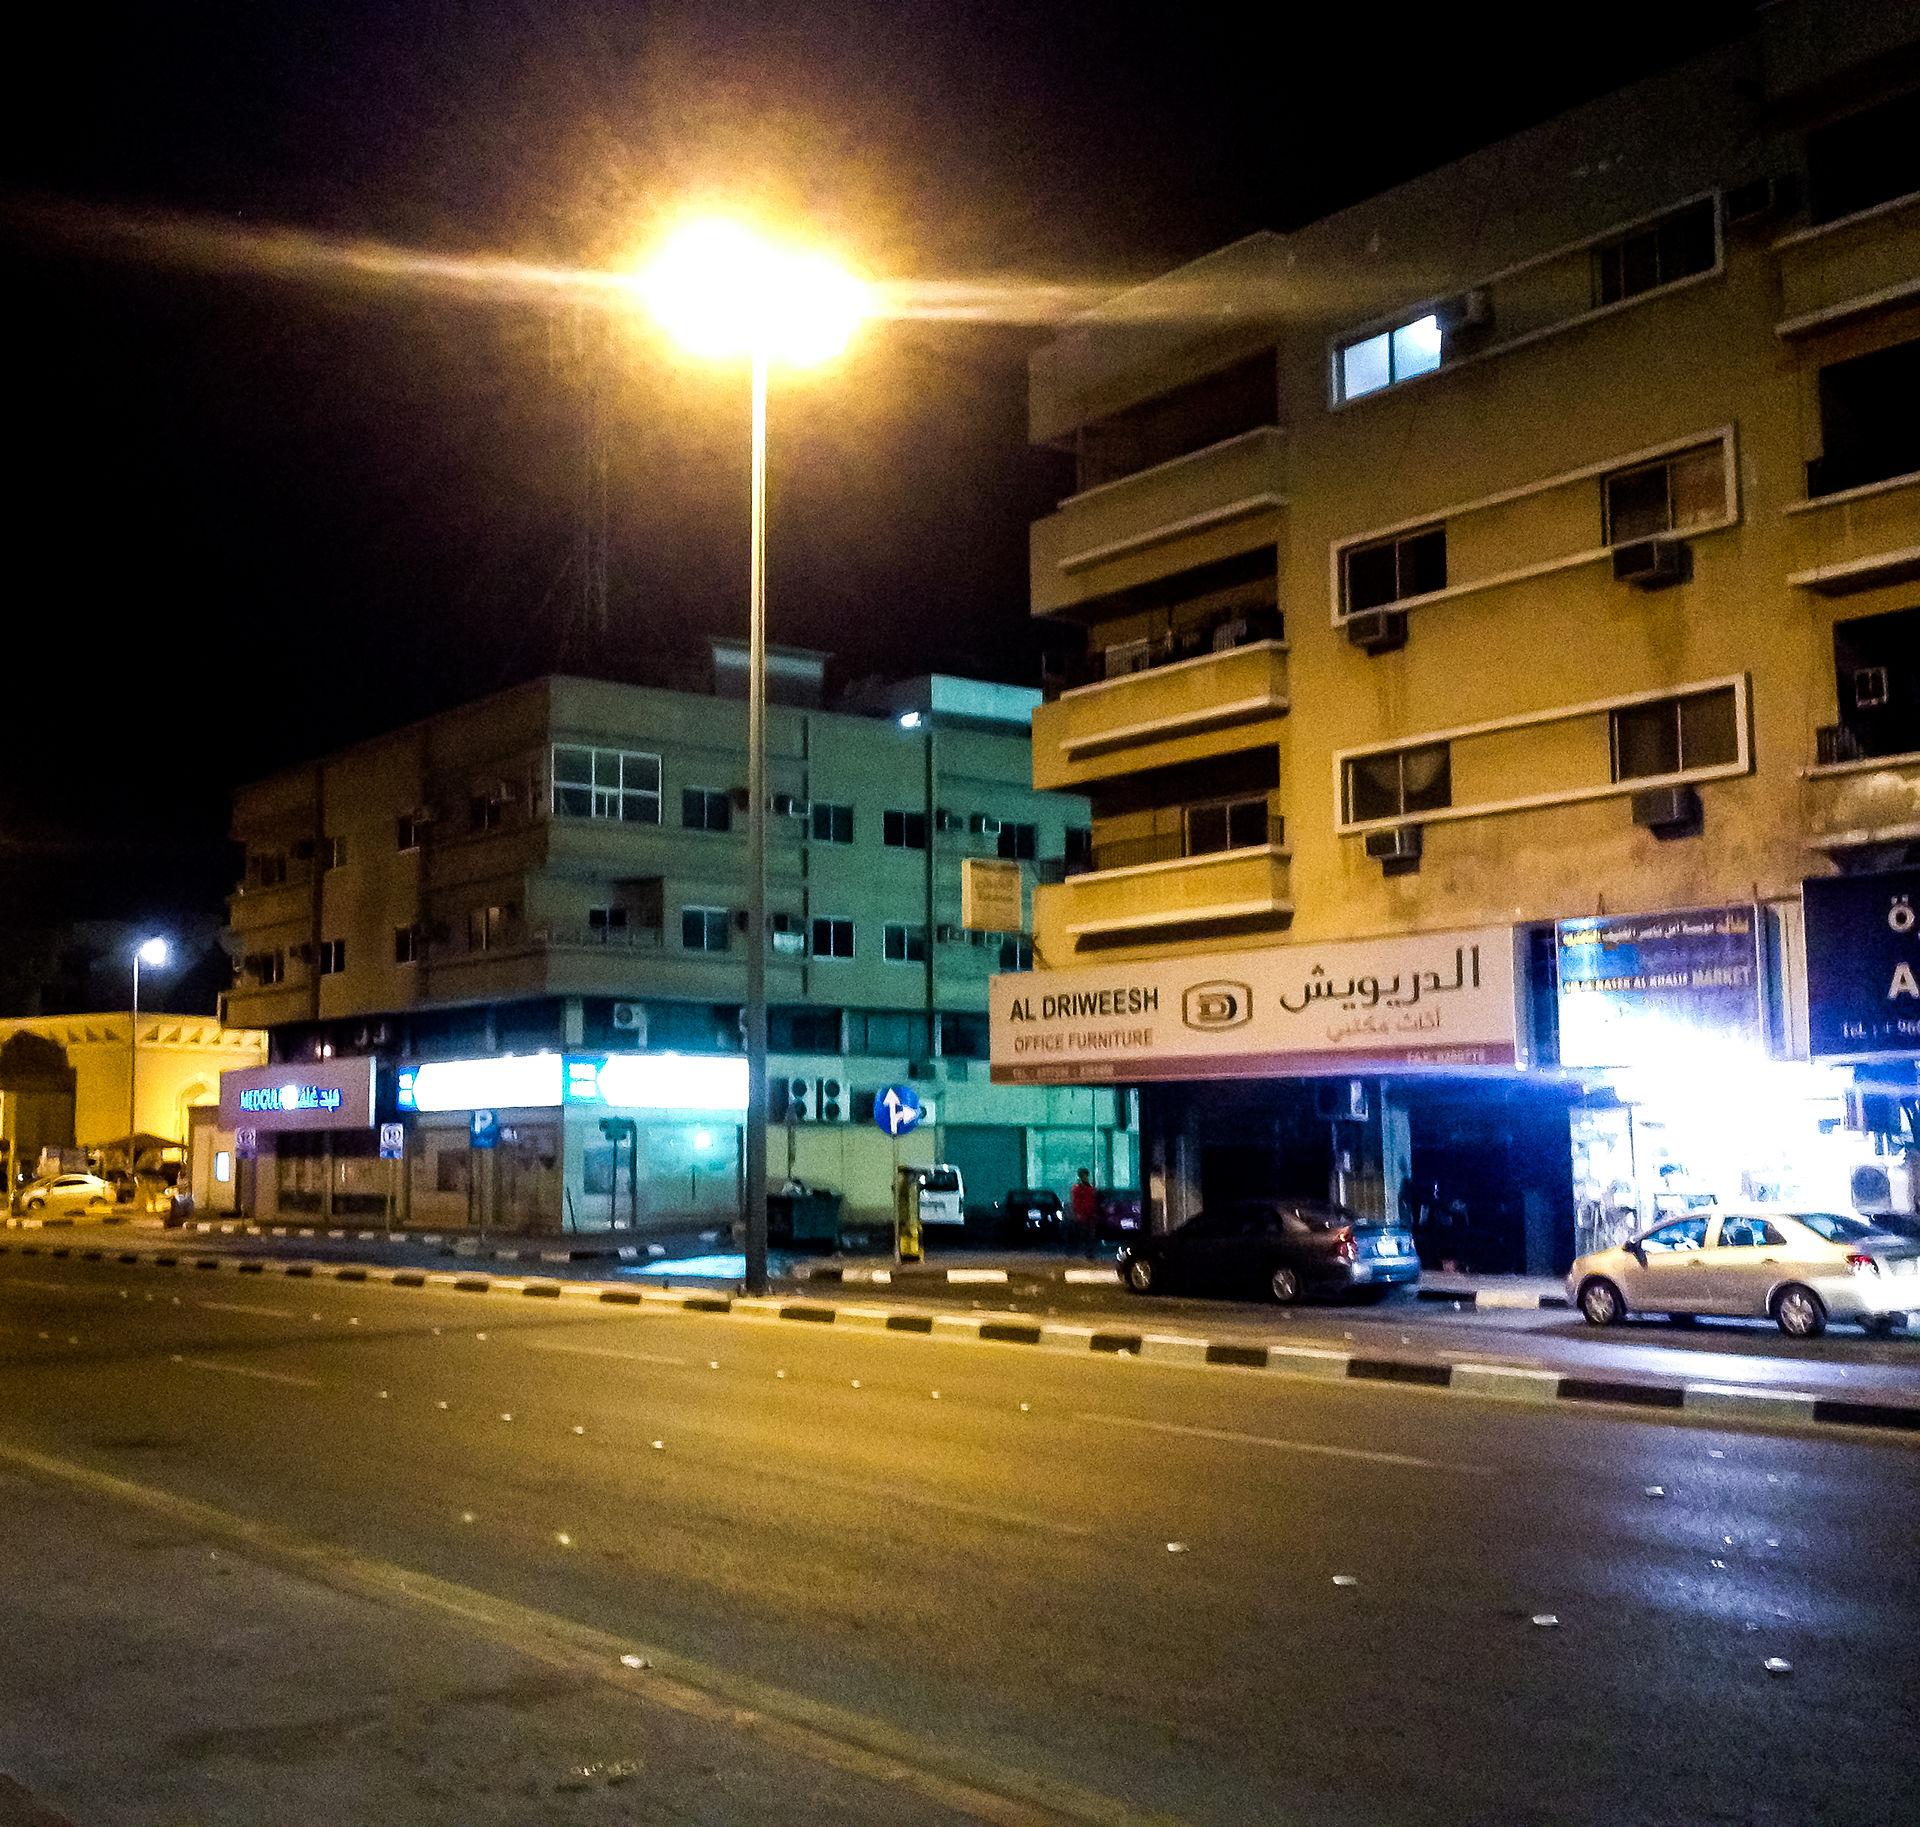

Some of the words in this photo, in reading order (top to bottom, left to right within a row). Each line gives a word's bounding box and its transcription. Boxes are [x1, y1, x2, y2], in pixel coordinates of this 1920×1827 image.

[1280, 945, 1480, 1014] الدريويش
[1009, 998, 1036, 1022] AL
[1042, 986, 1158, 1018] DRIWEESH
[1014, 1033, 1063, 1053] OFFICE
[1068, 1027, 1153, 1050] FURNITURE
[474, 1110, 493, 1135] P
